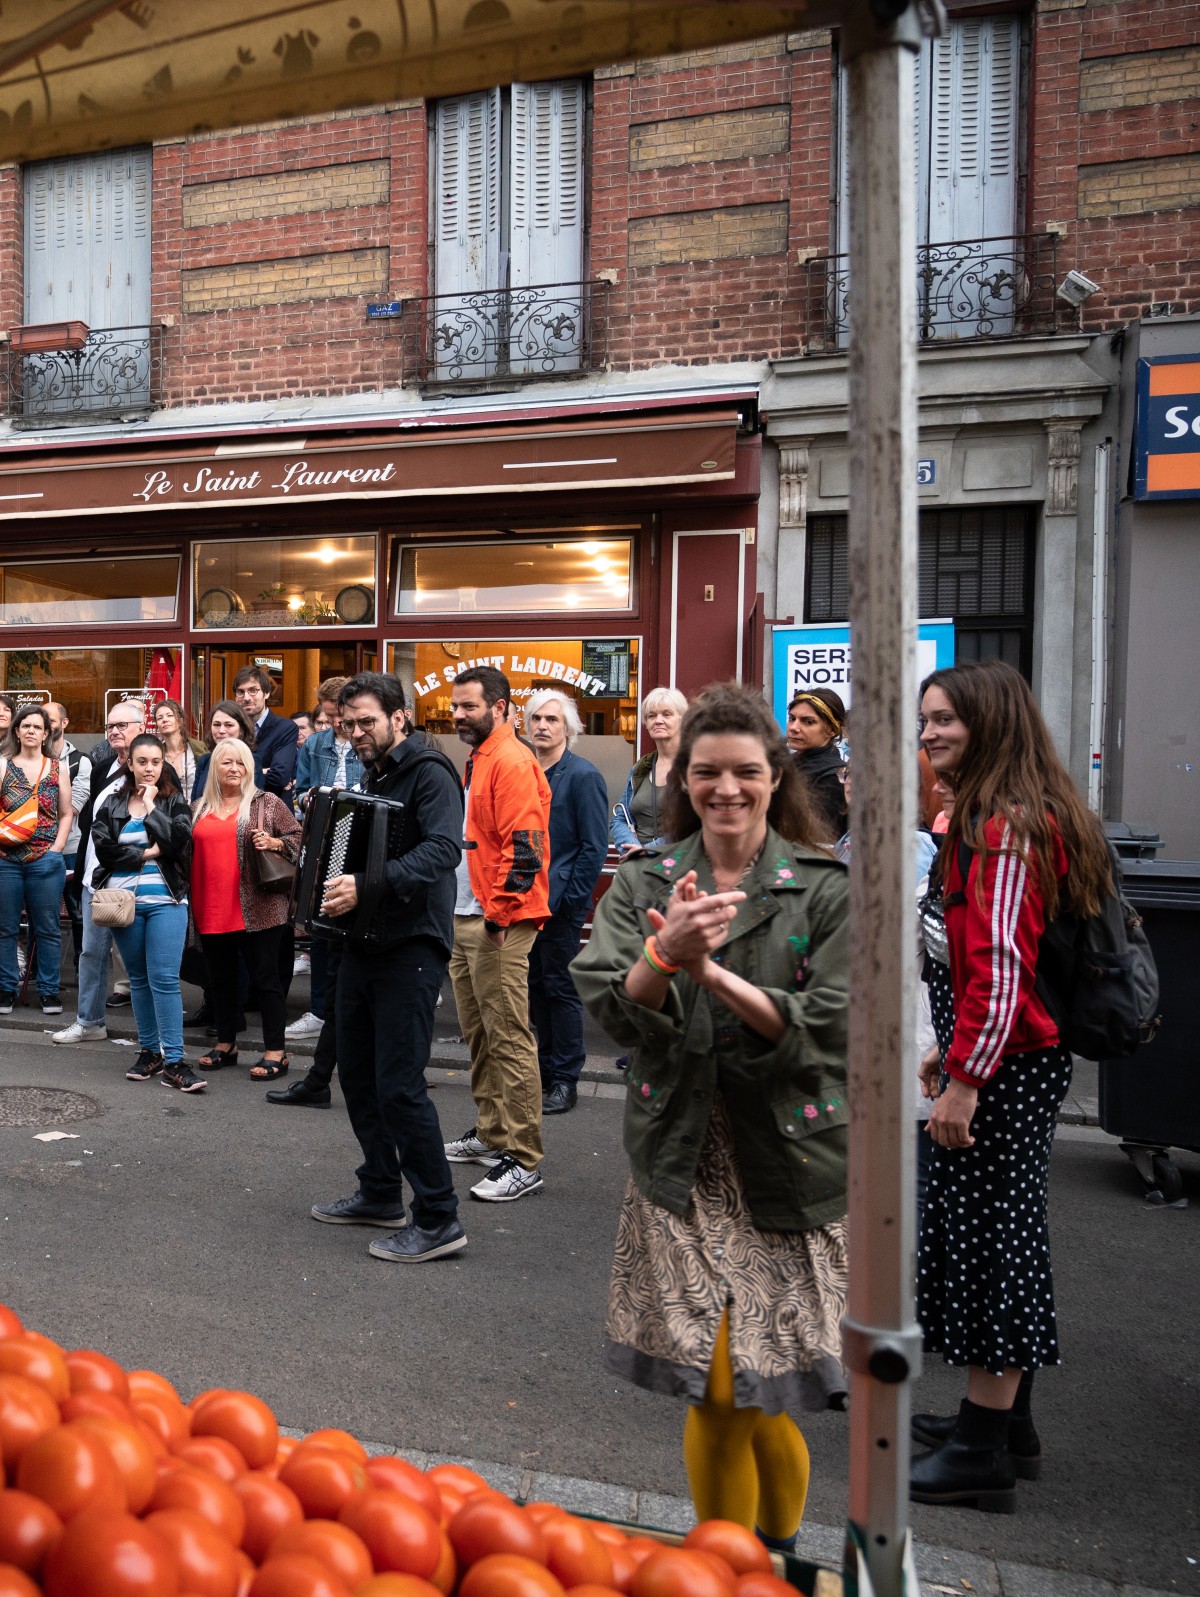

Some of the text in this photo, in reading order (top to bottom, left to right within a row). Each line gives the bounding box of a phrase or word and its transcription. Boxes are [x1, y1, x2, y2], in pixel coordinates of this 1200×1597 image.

[375, 303, 393, 312] GAZ
[132, 461, 398, 502] Le Saint Laurent
[917, 461, 932, 483] 5
[413, 672, 441, 697] LE
[443, 655, 505, 683] SAINT
[511, 655, 606, 696] LAURENT
[16, 694, 45, 702] Salades
